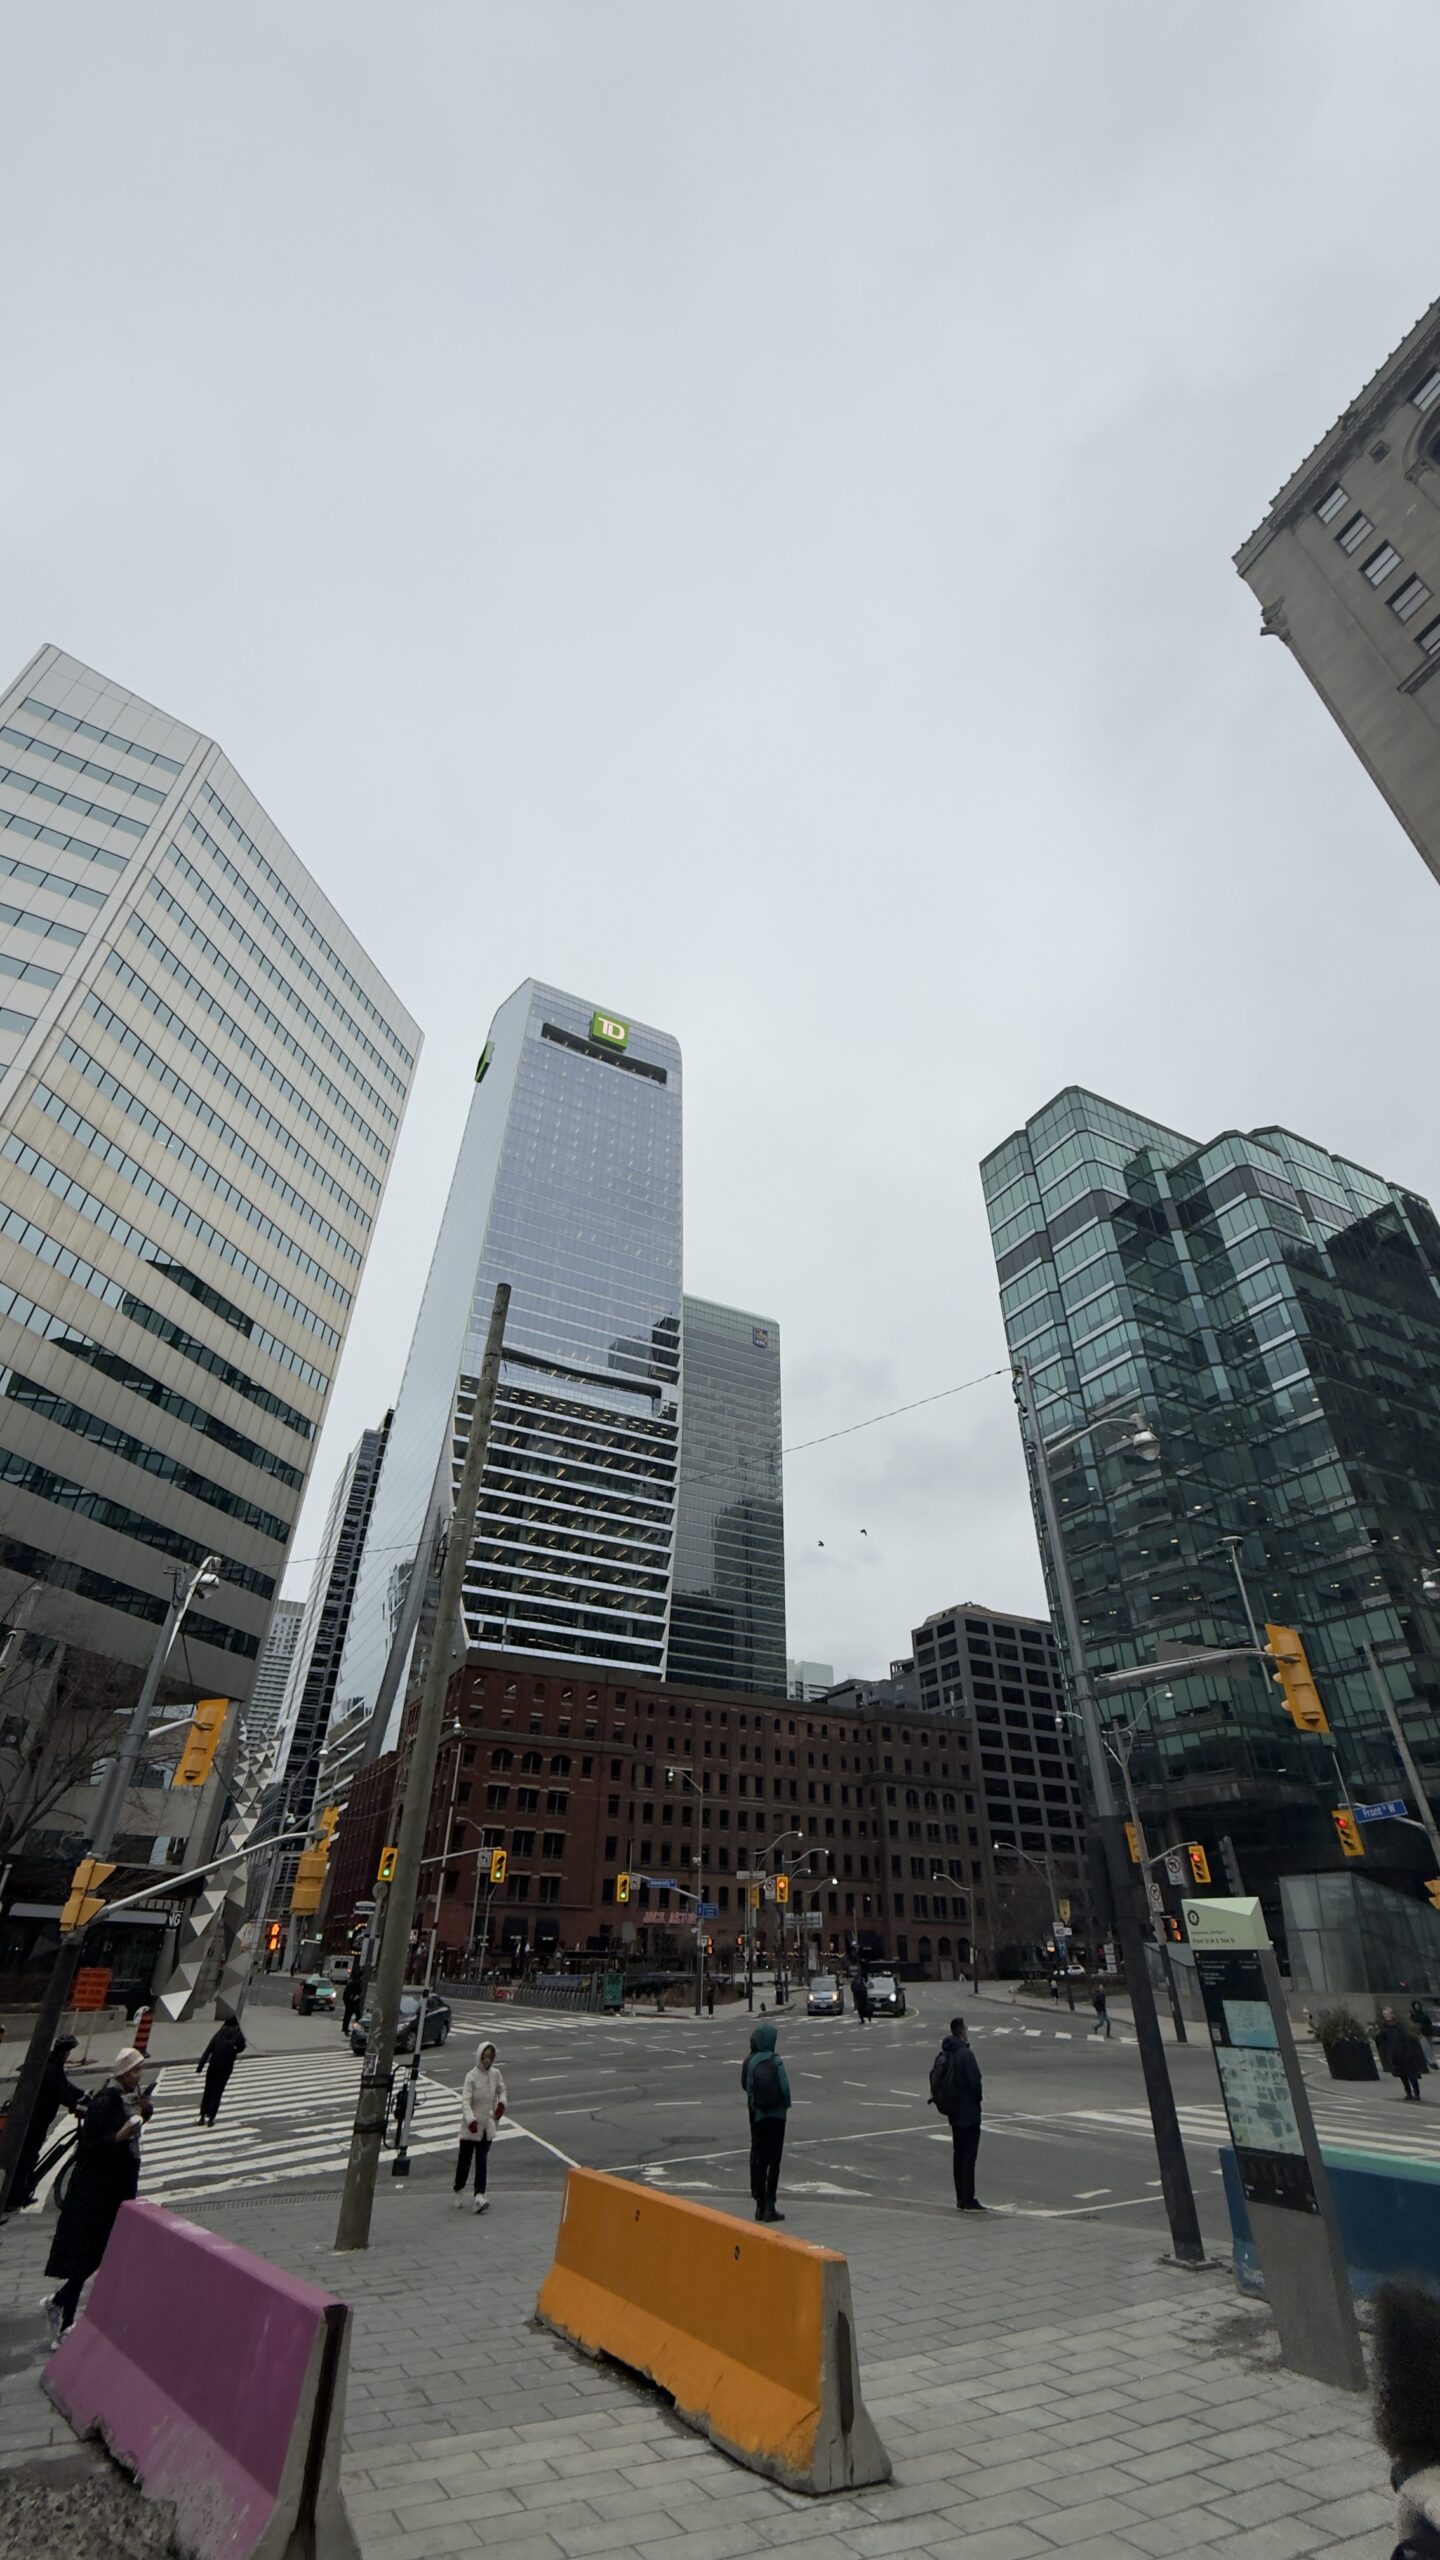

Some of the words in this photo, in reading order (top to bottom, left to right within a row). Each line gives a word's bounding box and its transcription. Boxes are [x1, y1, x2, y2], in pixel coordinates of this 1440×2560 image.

[598, 1017, 625, 1040] TD
[1362, 1806, 1382, 1818] Front
[1387, 1803, 1396, 1813] W
